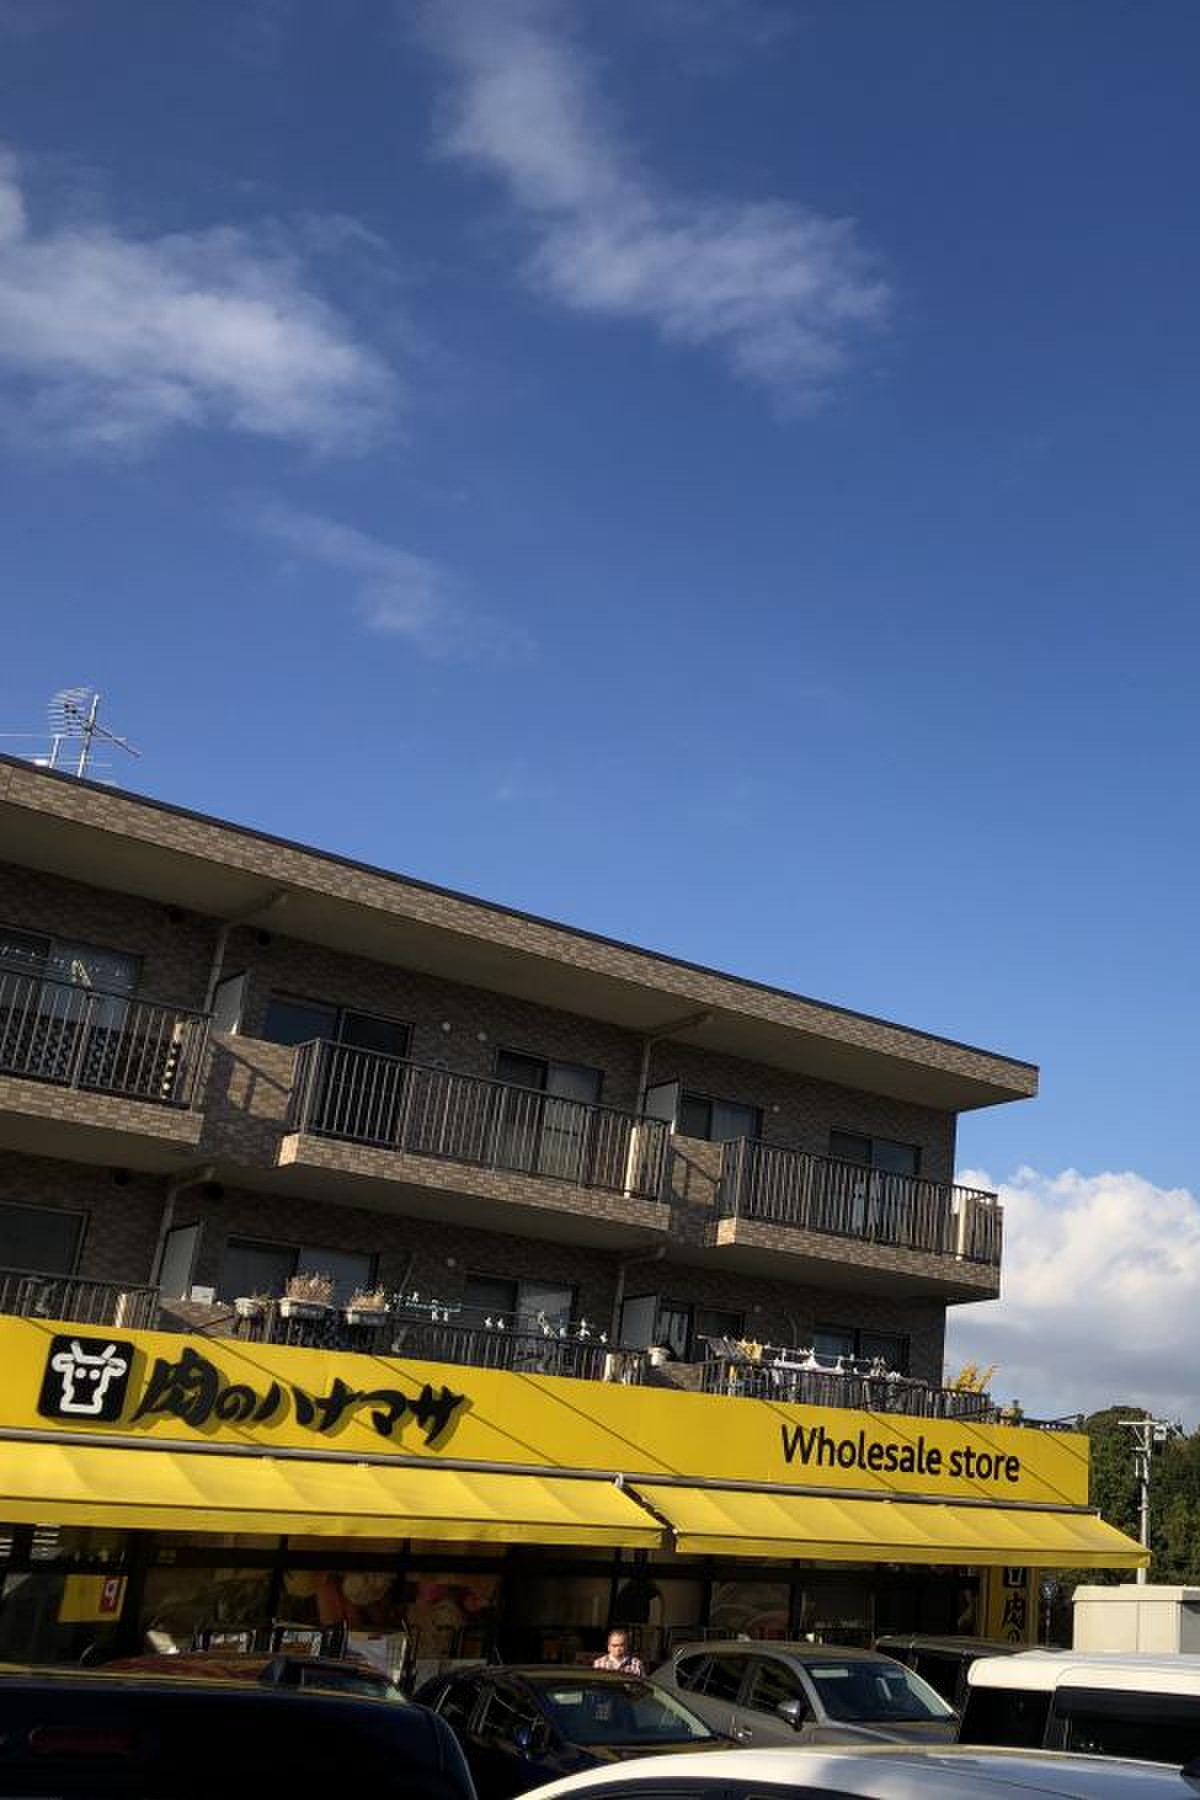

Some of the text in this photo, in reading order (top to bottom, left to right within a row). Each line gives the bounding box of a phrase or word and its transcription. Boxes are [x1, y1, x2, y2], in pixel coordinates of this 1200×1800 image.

[131, 1347, 468, 1444] 肉のハナマサ
[781, 1424, 1021, 1482] Wholesale store
